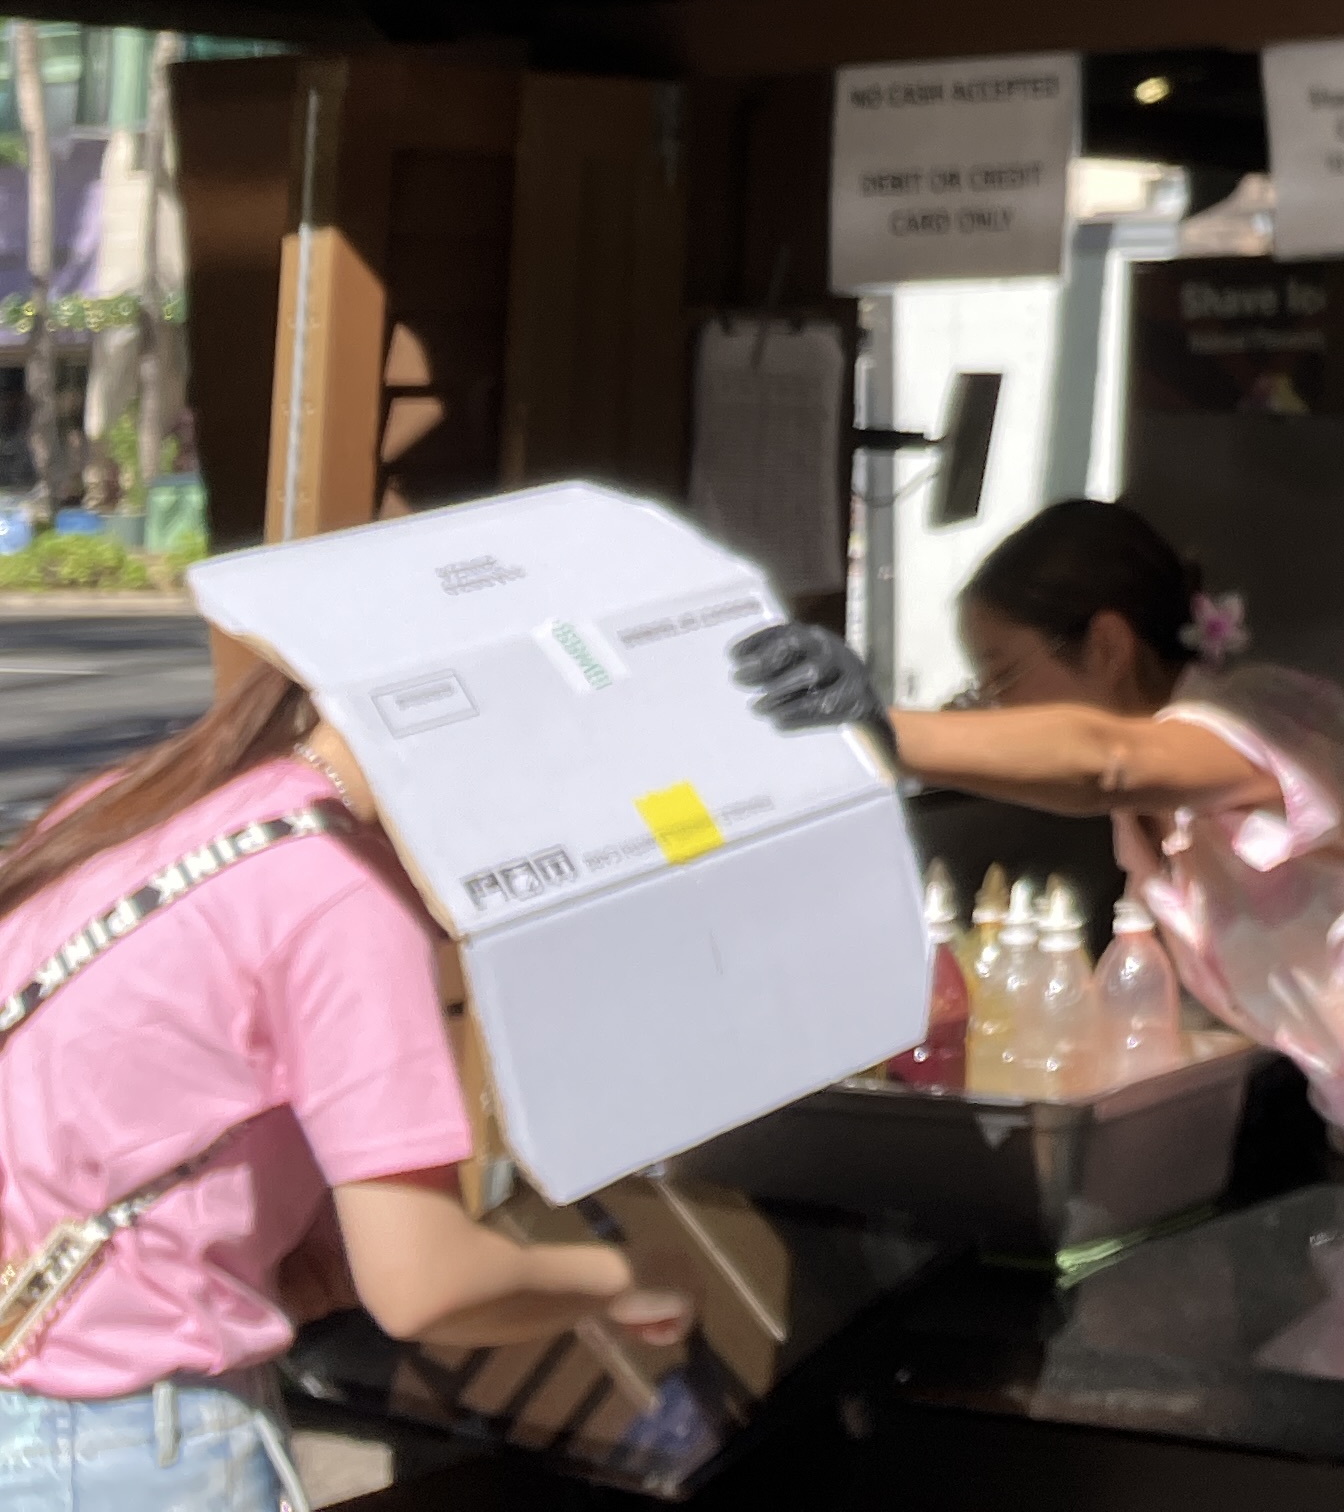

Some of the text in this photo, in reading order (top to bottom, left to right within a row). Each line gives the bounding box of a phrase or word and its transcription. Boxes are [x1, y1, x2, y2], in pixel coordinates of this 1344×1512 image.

[850, 74, 1059, 110] NO CASH ACCEPTED
[860, 160, 1042, 197] DEBIT OR CREDIT
[889, 206, 1014, 237] CARD ONLY
[38, 820, 271, 996] PINK PINK
